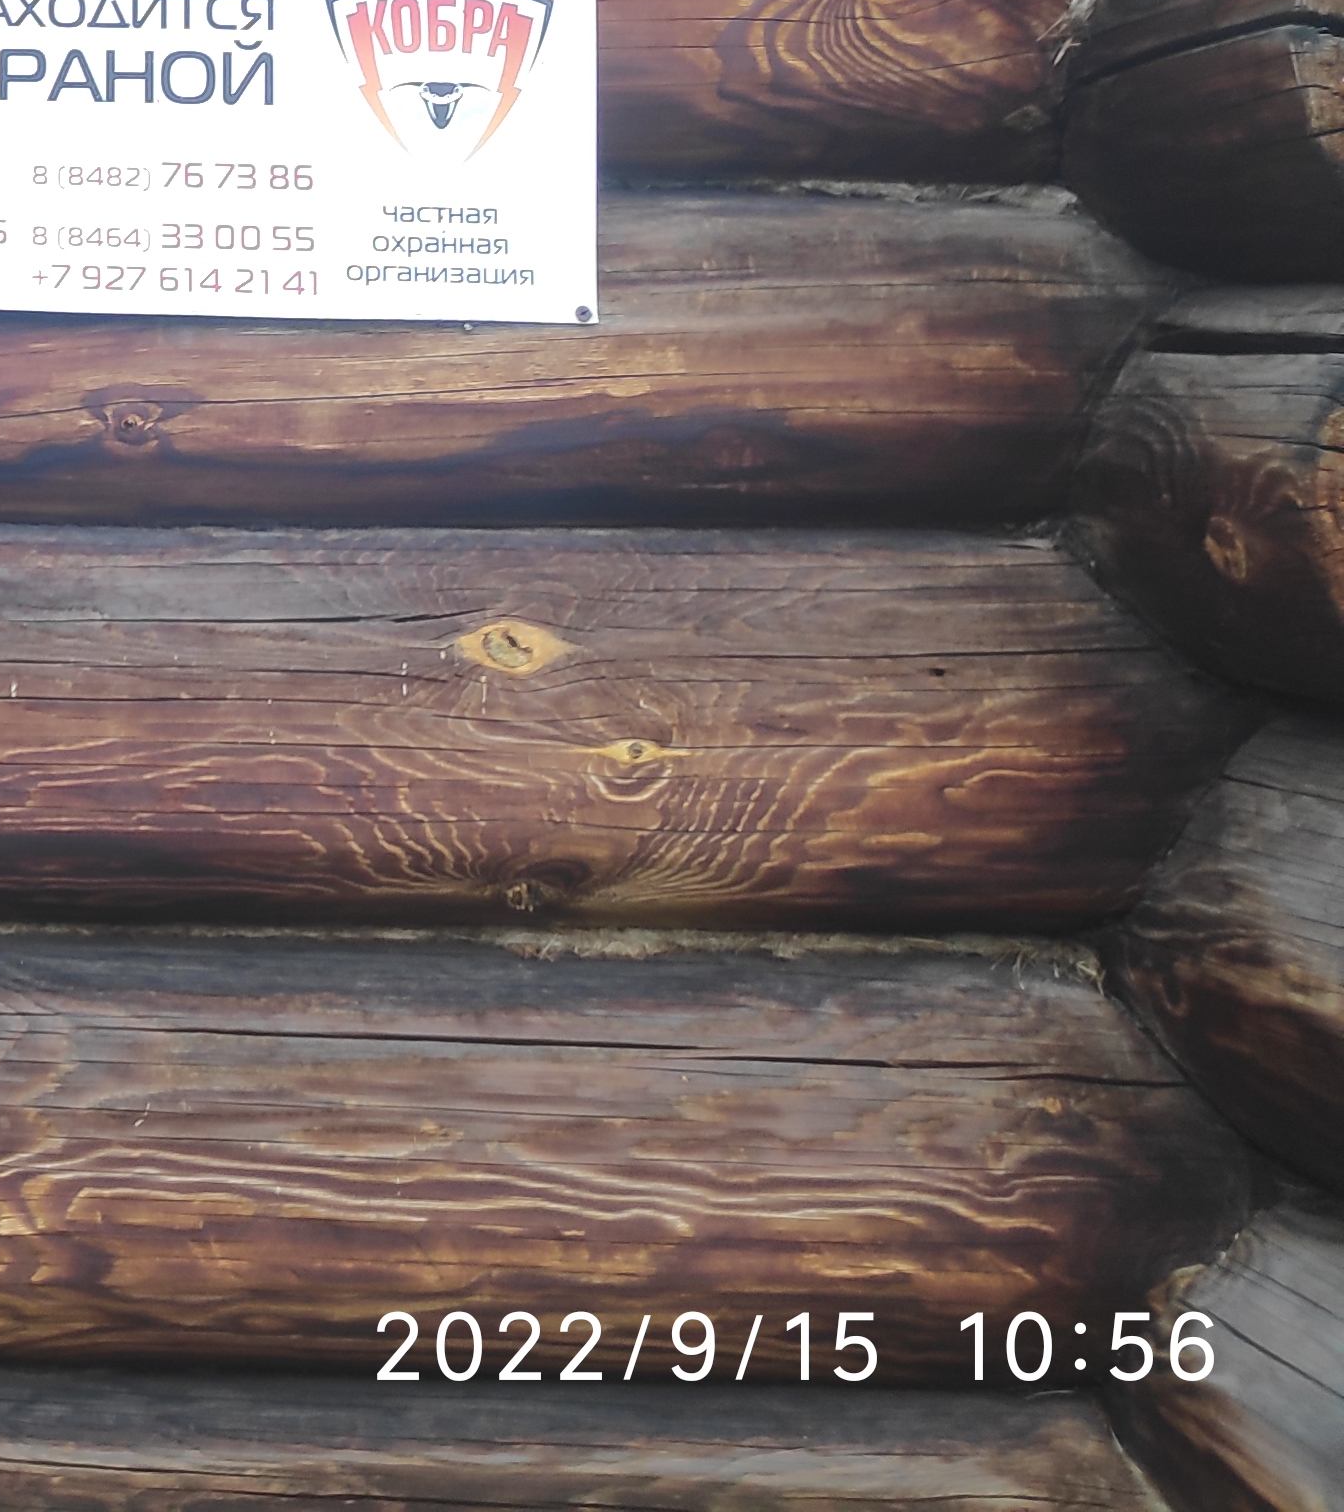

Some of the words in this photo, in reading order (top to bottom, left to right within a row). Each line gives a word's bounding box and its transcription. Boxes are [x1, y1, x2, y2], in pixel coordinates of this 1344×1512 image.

[32, 165, 48, 185] 8
[57, 162, 151, 191] (8482)
[160, 162, 204, 189] 76
[214, 163, 258, 190] 73
[268, 164, 314, 191] 86
[382, 205, 498, 225] частная
[32, 226, 48, 247] 8
[57, 224, 151, 253] (8464)
[160, 222, 204, 249] 33
[213, 224, 261, 251] 00
[269, 225, 315, 252] 55
[371, 234, 508, 257] охранная
[32, 266, 75, 290] +7
[80, 267, 147, 293] 927
[158, 267, 225, 294] 614
[234, 269, 277, 295] 21
[283, 271, 319, 296] 41
[346, 264, 535, 286] организация
